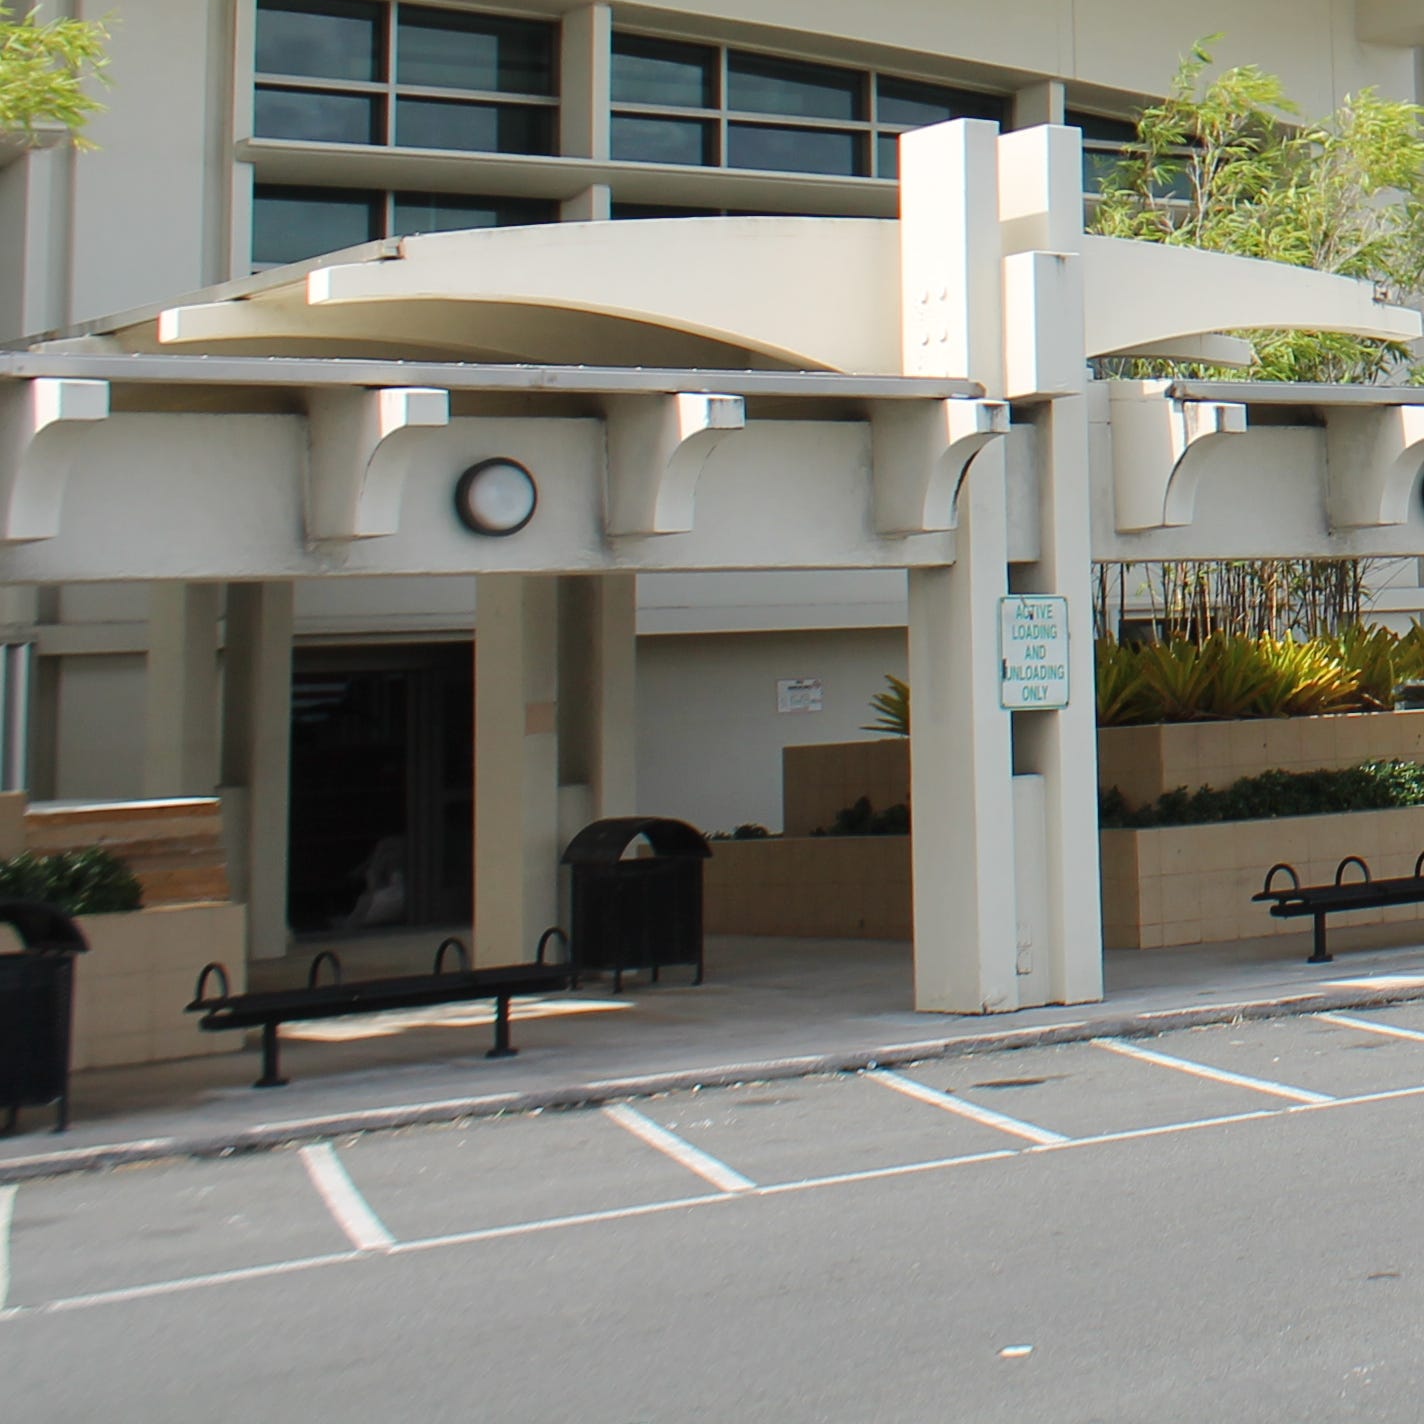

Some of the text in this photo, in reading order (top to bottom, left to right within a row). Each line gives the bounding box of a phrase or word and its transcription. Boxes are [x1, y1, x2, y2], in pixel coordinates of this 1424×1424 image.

[1015, 604, 1053, 619] ACTIVE
[1011, 624, 1058, 640] LOADING
[1024, 644, 1047, 660] AND
[1005, 664, 1065, 680] UNLOADING
[1021, 685, 1049, 701] ONLY
